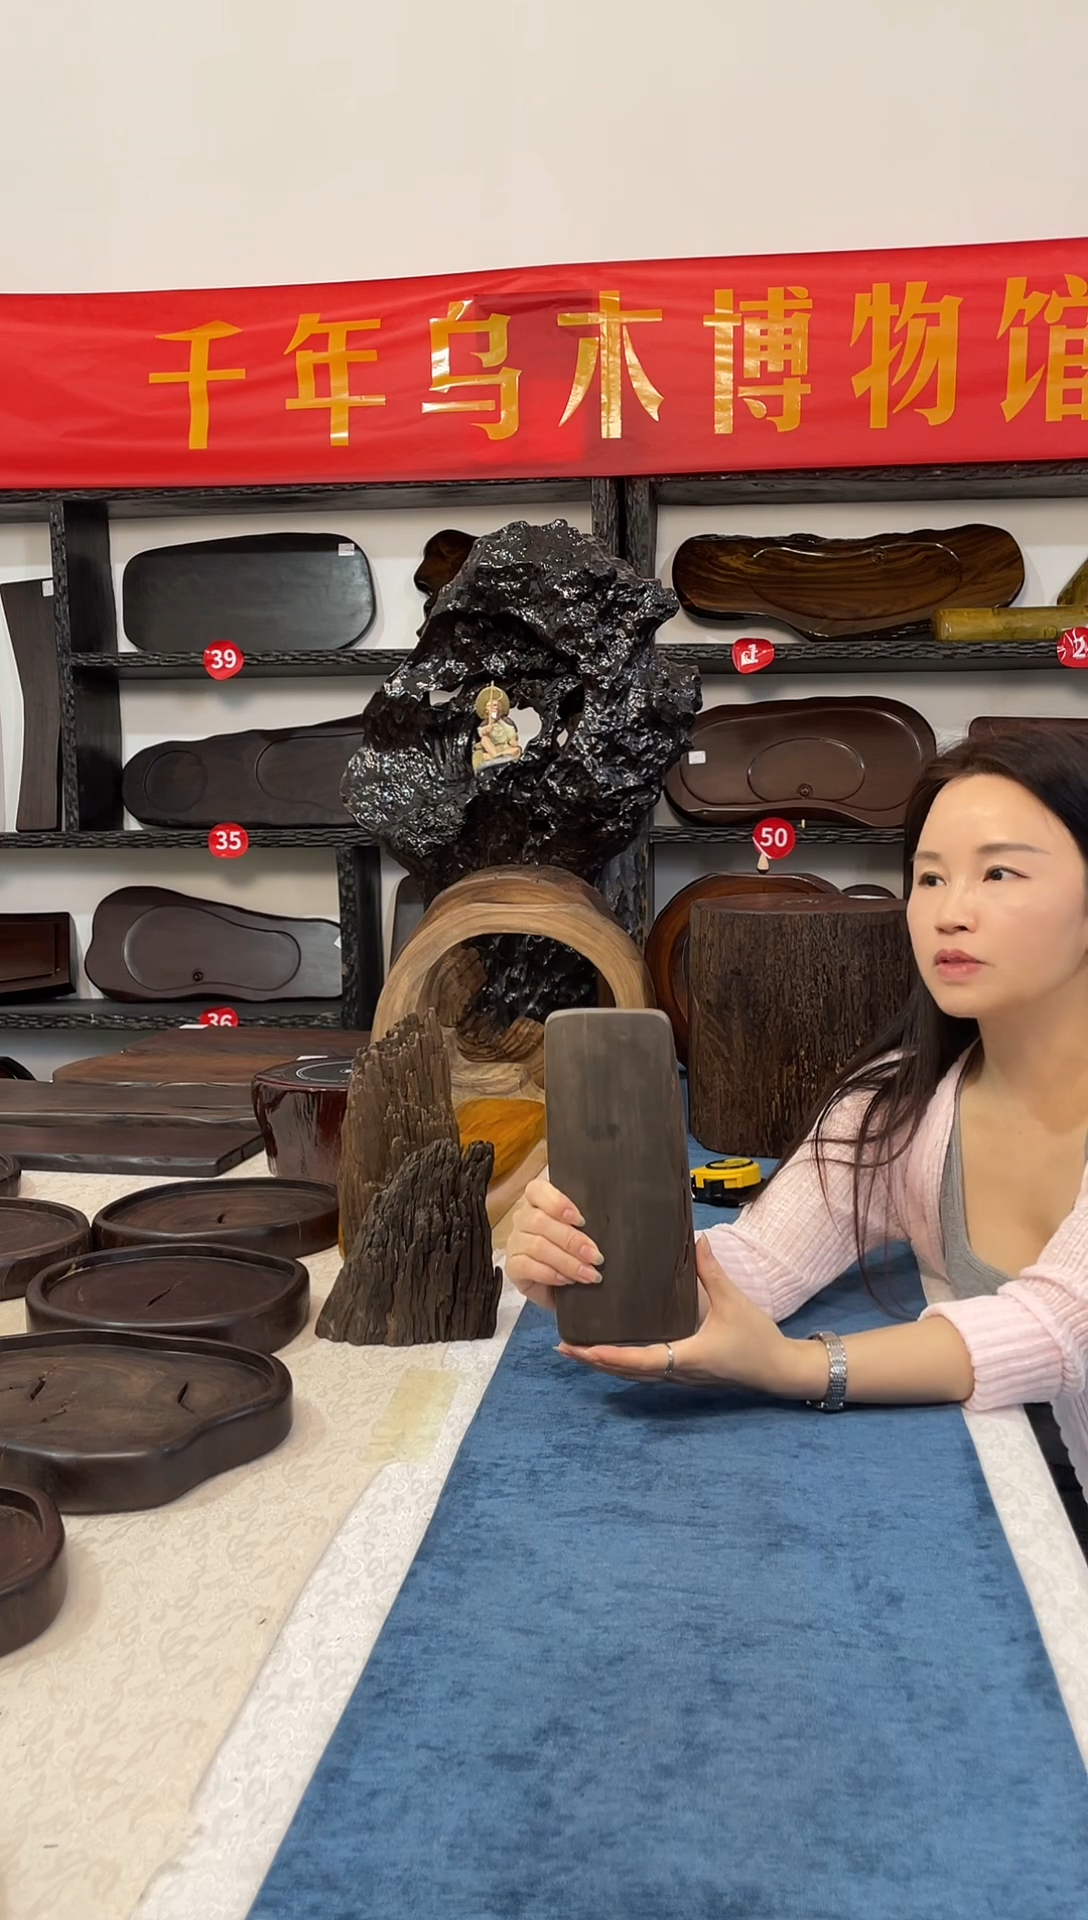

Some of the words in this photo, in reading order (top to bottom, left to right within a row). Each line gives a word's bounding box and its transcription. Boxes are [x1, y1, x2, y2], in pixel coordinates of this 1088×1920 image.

[149, 274, 1088, 450] 千年乌木博物馆
[211, 649, 237, 669] 39
[216, 831, 242, 850] 35
[760, 827, 788, 847] 50
